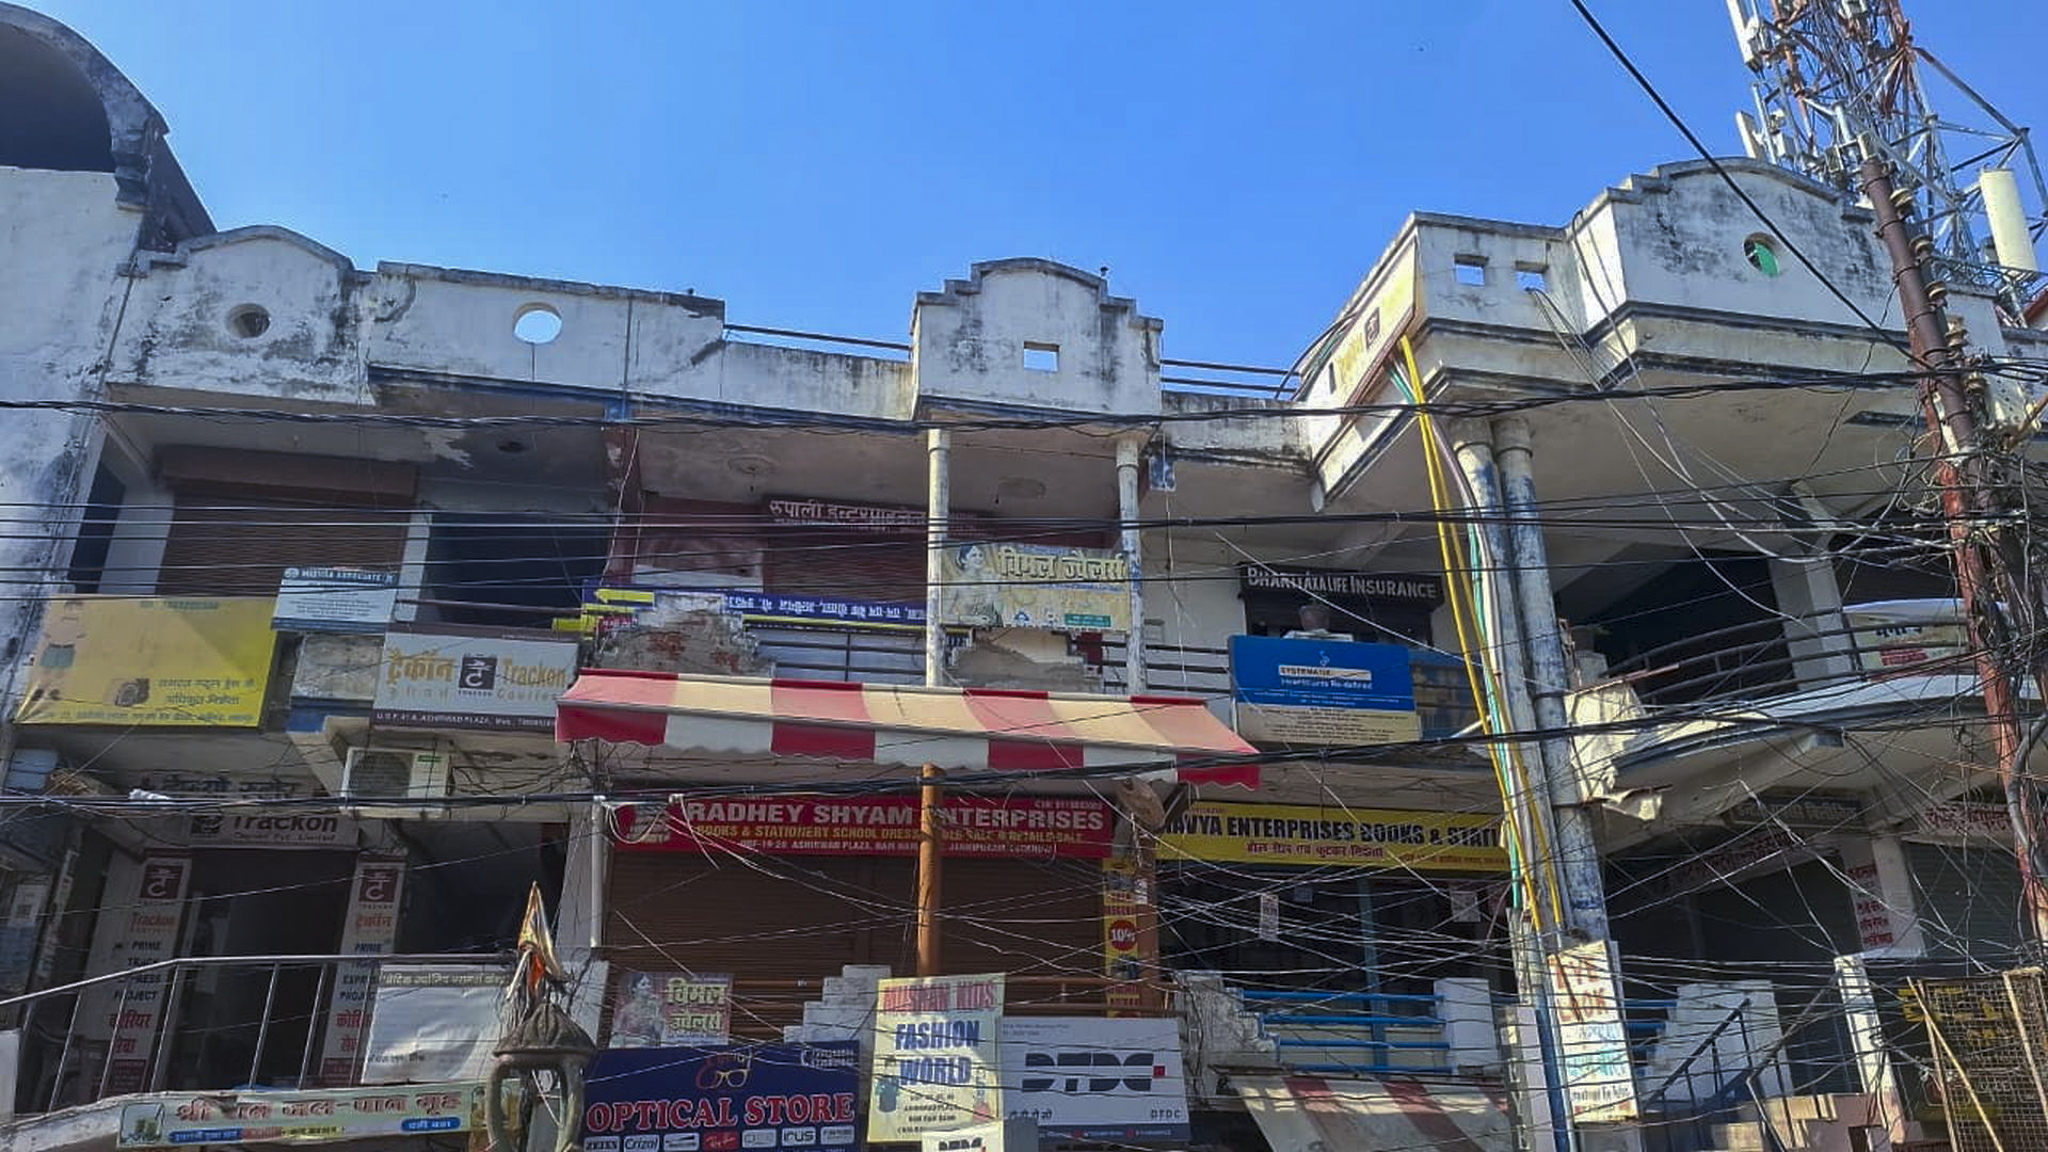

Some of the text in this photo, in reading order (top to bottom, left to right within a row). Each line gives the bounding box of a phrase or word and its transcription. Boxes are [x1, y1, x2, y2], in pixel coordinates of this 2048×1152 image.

[1350, 574, 1438, 598] INSURANCE
[687, 802, 1103, 829] RADHEY SHYAM NTERPRISES
[1227, 816, 1356, 843] ENTERPRISES
[1360, 821, 1425, 844] BOOKS
[1429, 827, 1443, 844] &
[895, 1020, 980, 1050] FASHION
[899, 1056, 972, 1087] WORLD
[1020, 1052, 1155, 1093] DTDC
[586, 1092, 856, 1133] OPTICAL STORE
[1151, 1108, 1181, 1120] DTDC
